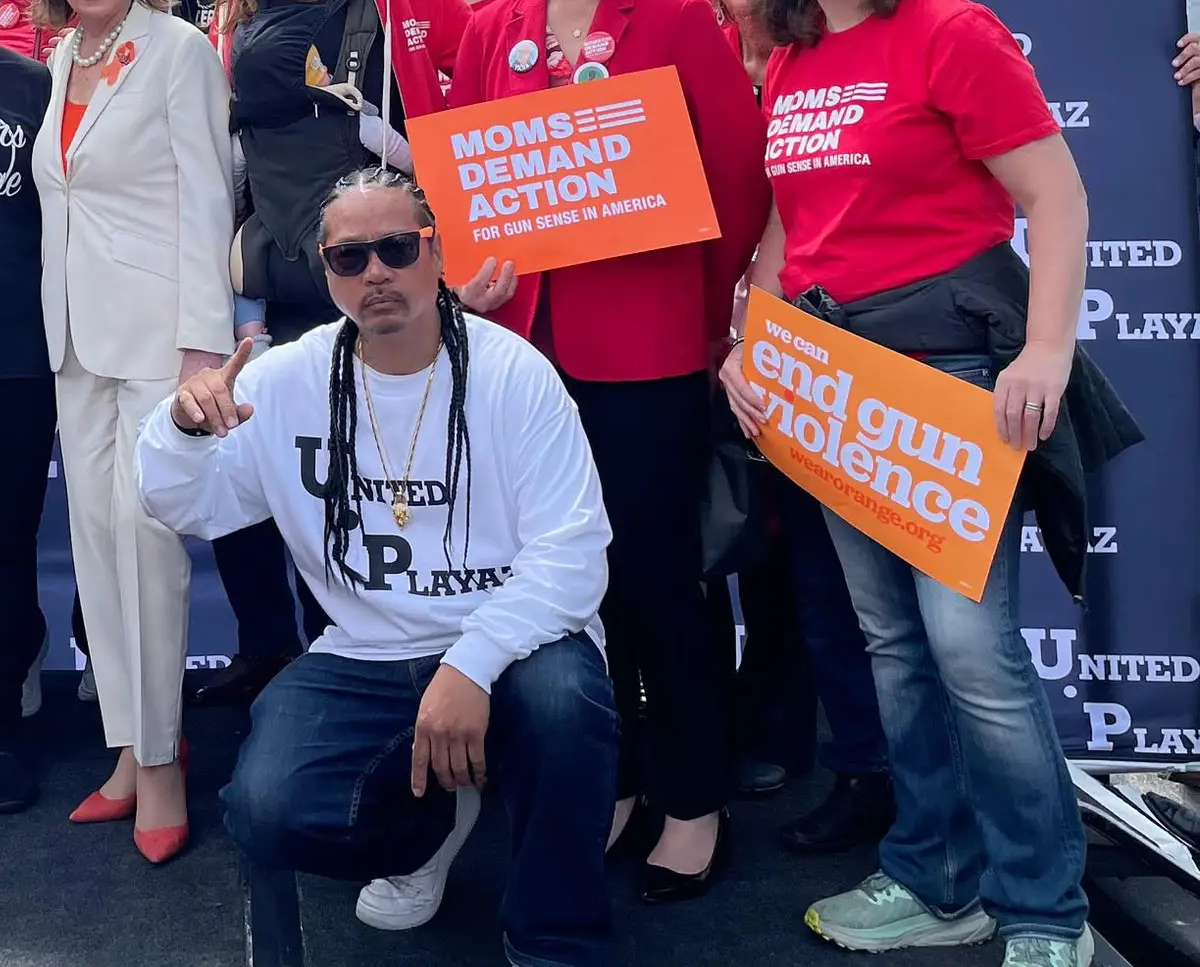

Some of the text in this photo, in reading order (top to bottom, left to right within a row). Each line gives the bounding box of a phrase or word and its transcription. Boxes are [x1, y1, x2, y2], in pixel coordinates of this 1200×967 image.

[407, 35, 424, 47] ACT
[766, 104, 864, 138] DEMAND
[772, 85, 843, 116] MOMS
[451, 112, 574, 160] MOMS
[458, 134, 631, 190] DEMAND
[788, 159, 812, 174] SENSE
[813, 158, 821, 170] IN
[824, 153, 871, 168] AMERICA
[468, 168, 618, 222] ACTION
[473, 193, 667, 243] FOR GUN SENSE IN AMERICA
[765, 318, 829, 365] we can
[752, 340, 984, 487] end gun
[750, 381, 991, 543] violence
[788, 445, 946, 555] wearorange.org
[1020, 628, 1200, 682] UNITED
